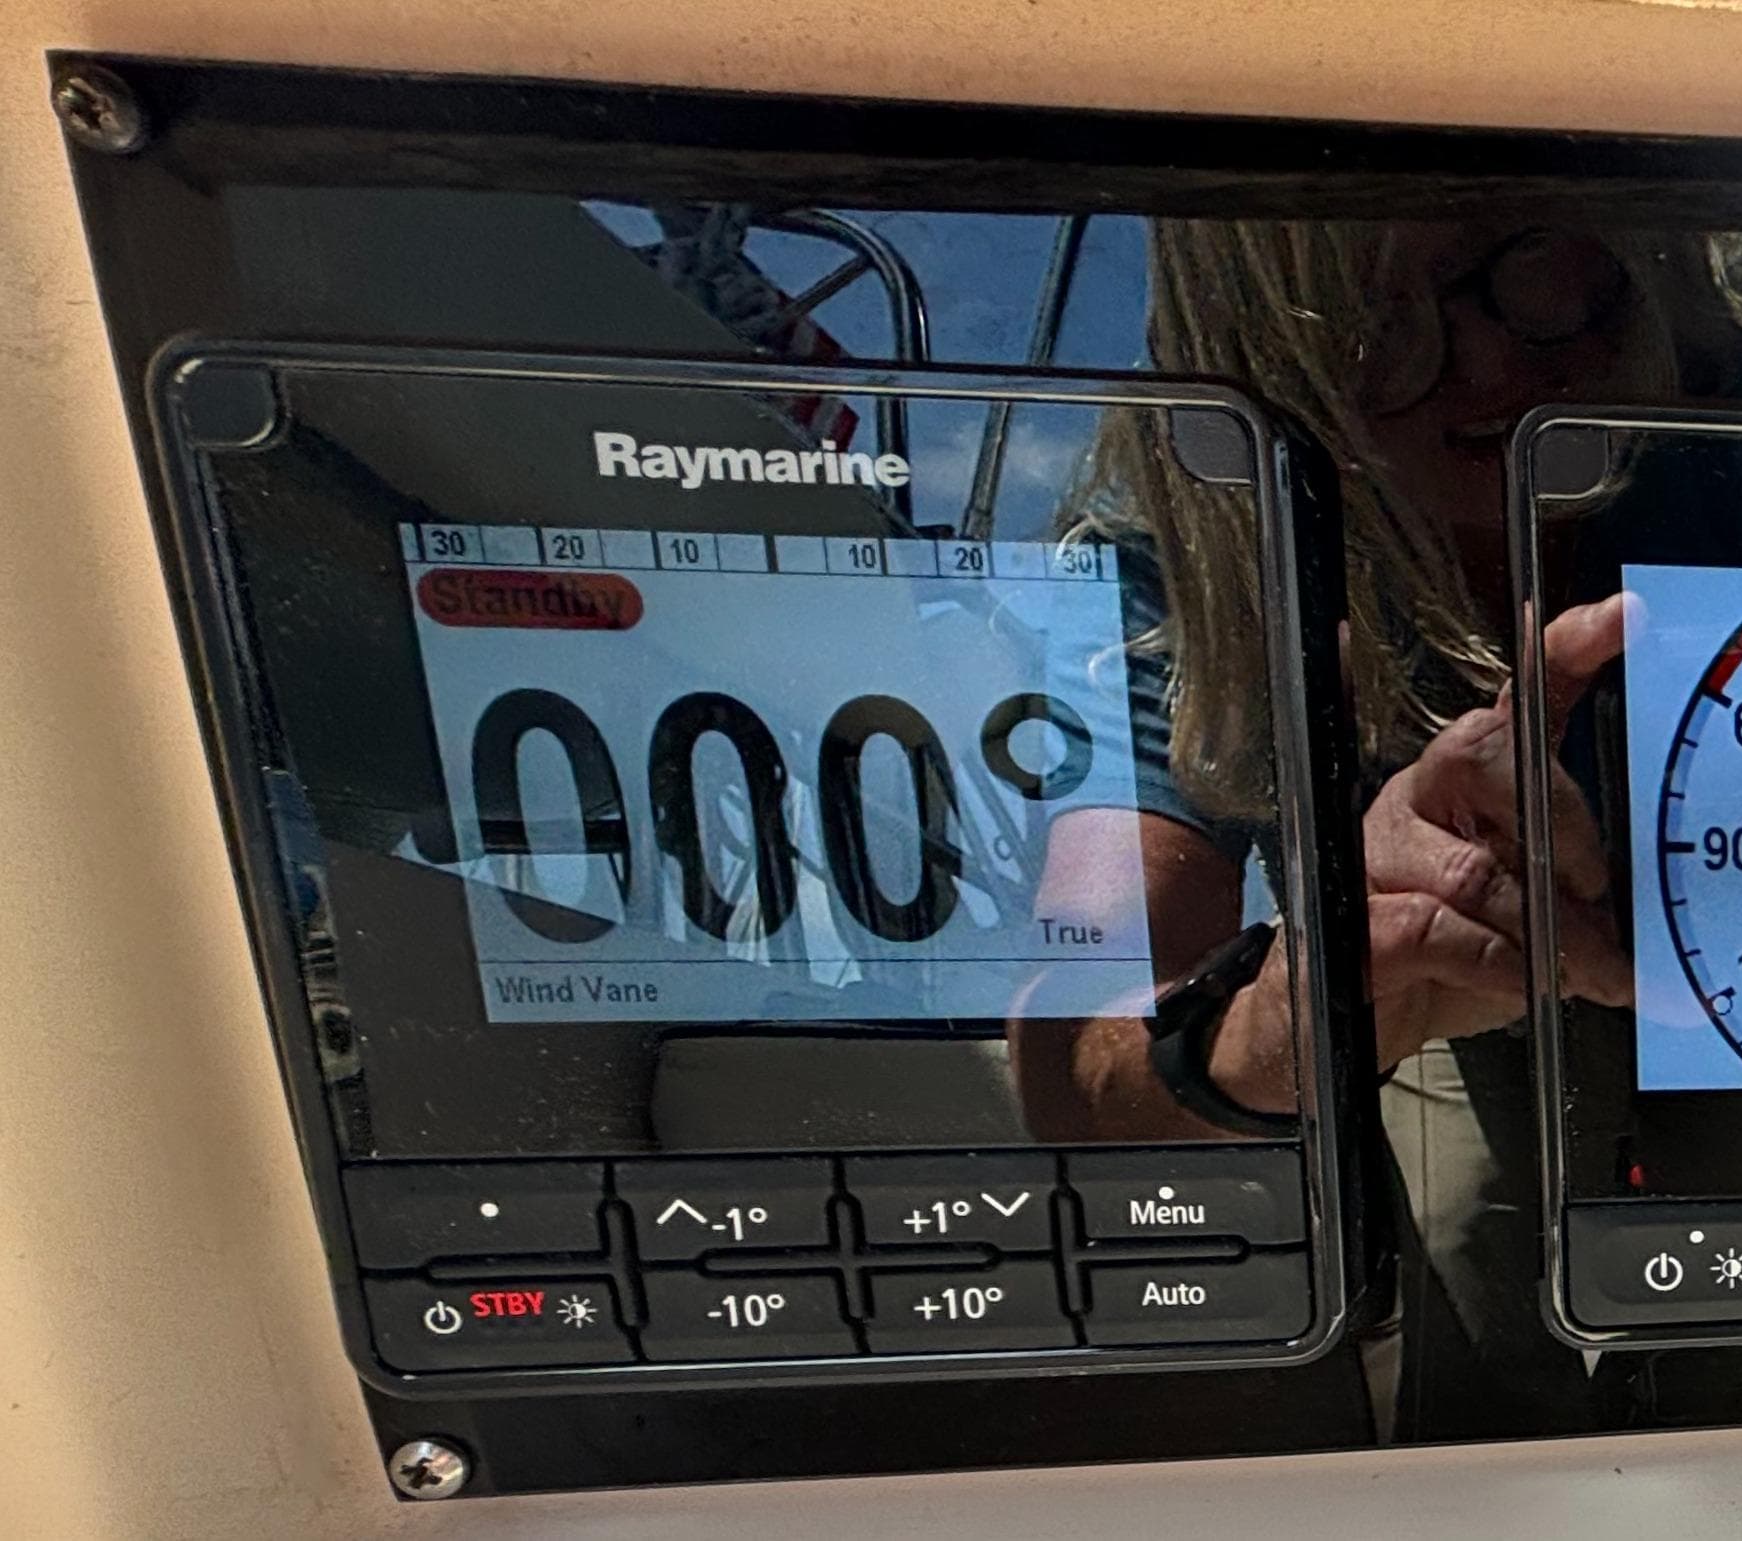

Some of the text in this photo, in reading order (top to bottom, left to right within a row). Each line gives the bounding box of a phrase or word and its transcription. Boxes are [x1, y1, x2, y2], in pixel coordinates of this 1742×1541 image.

[593, 431, 911, 489] Raymarine
[432, 531, 466, 556] 30
[552, 535, 586, 560] 20
[671, 539, 700, 564] 10
[848, 544, 877, 569] 10
[954, 547, 984, 571] 20
[1062, 550, 1092, 574] 30
[431, 573, 625, 626] Standby
[1041, 918, 1104, 946] True
[498, 976, 658, 1004] Wind Vane
[1130, 1200, 1204, 1226] Menu
[470, 1291, 545, 1319] STBY
[1142, 1281, 1206, 1306] Auto
